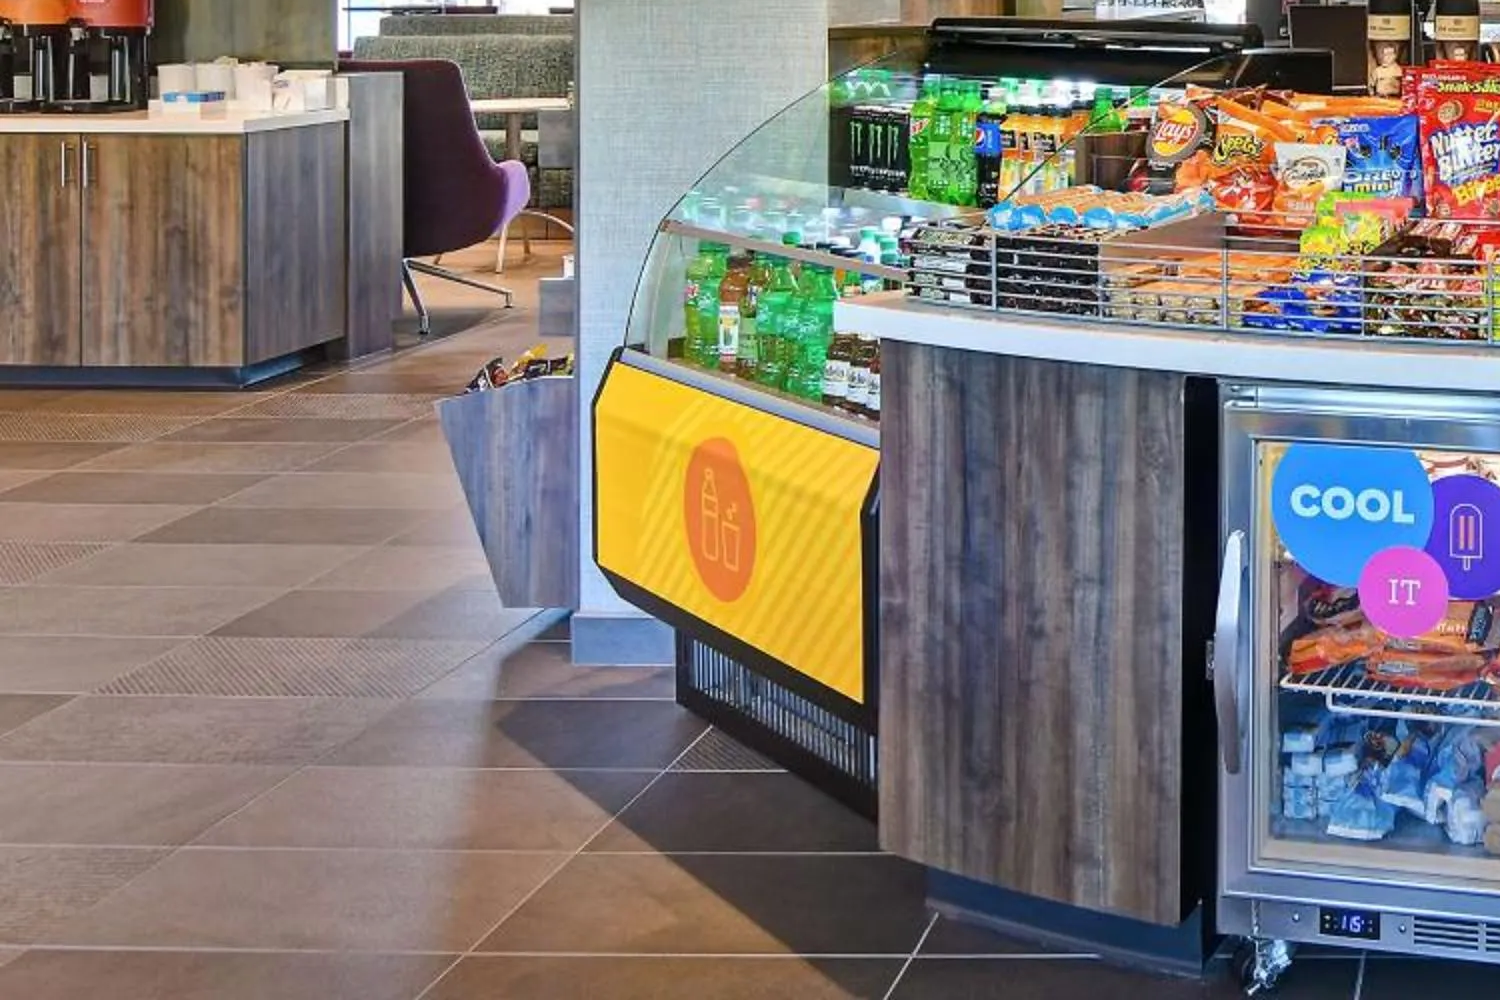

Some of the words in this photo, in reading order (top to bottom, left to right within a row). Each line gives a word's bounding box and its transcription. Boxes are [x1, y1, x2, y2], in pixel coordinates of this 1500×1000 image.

[1430, 122, 1498, 158] Nutter
[1290, 483, 1416, 525] COOL
[1387, 578, 1422, 606] IT
